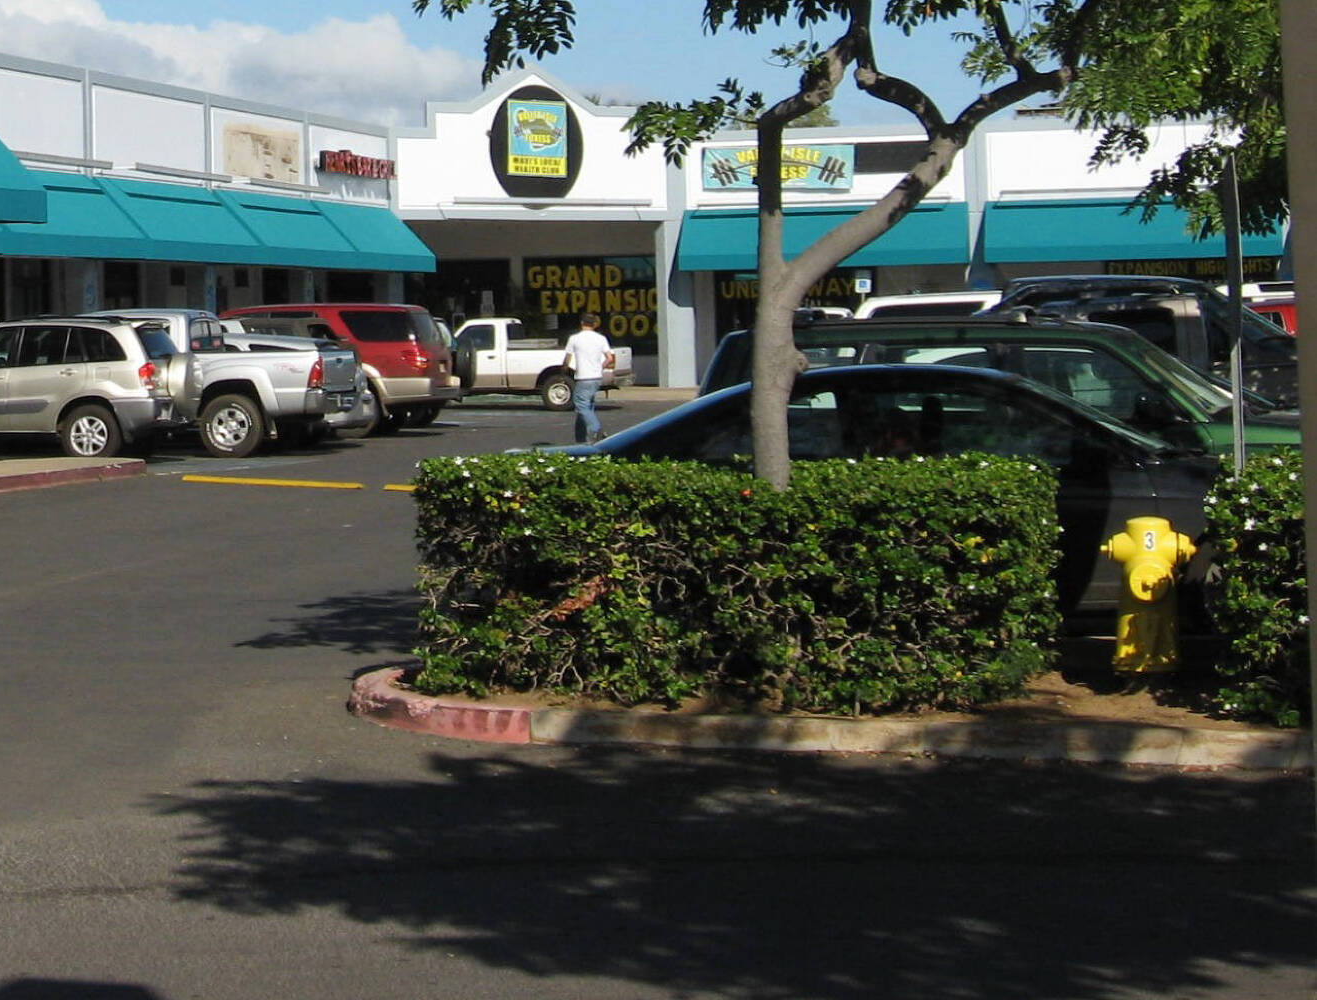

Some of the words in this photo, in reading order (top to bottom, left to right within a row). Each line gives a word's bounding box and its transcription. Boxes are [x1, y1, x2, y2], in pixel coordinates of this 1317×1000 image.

[527, 264, 622, 289] GRAND
[1108, 260, 1188, 275] EXPANSION
[1195, 257, 1273, 275] HIGHGHTS
[540, 287, 659, 314] EXPANSIO
[1144, 531, 1155, 550] 3
